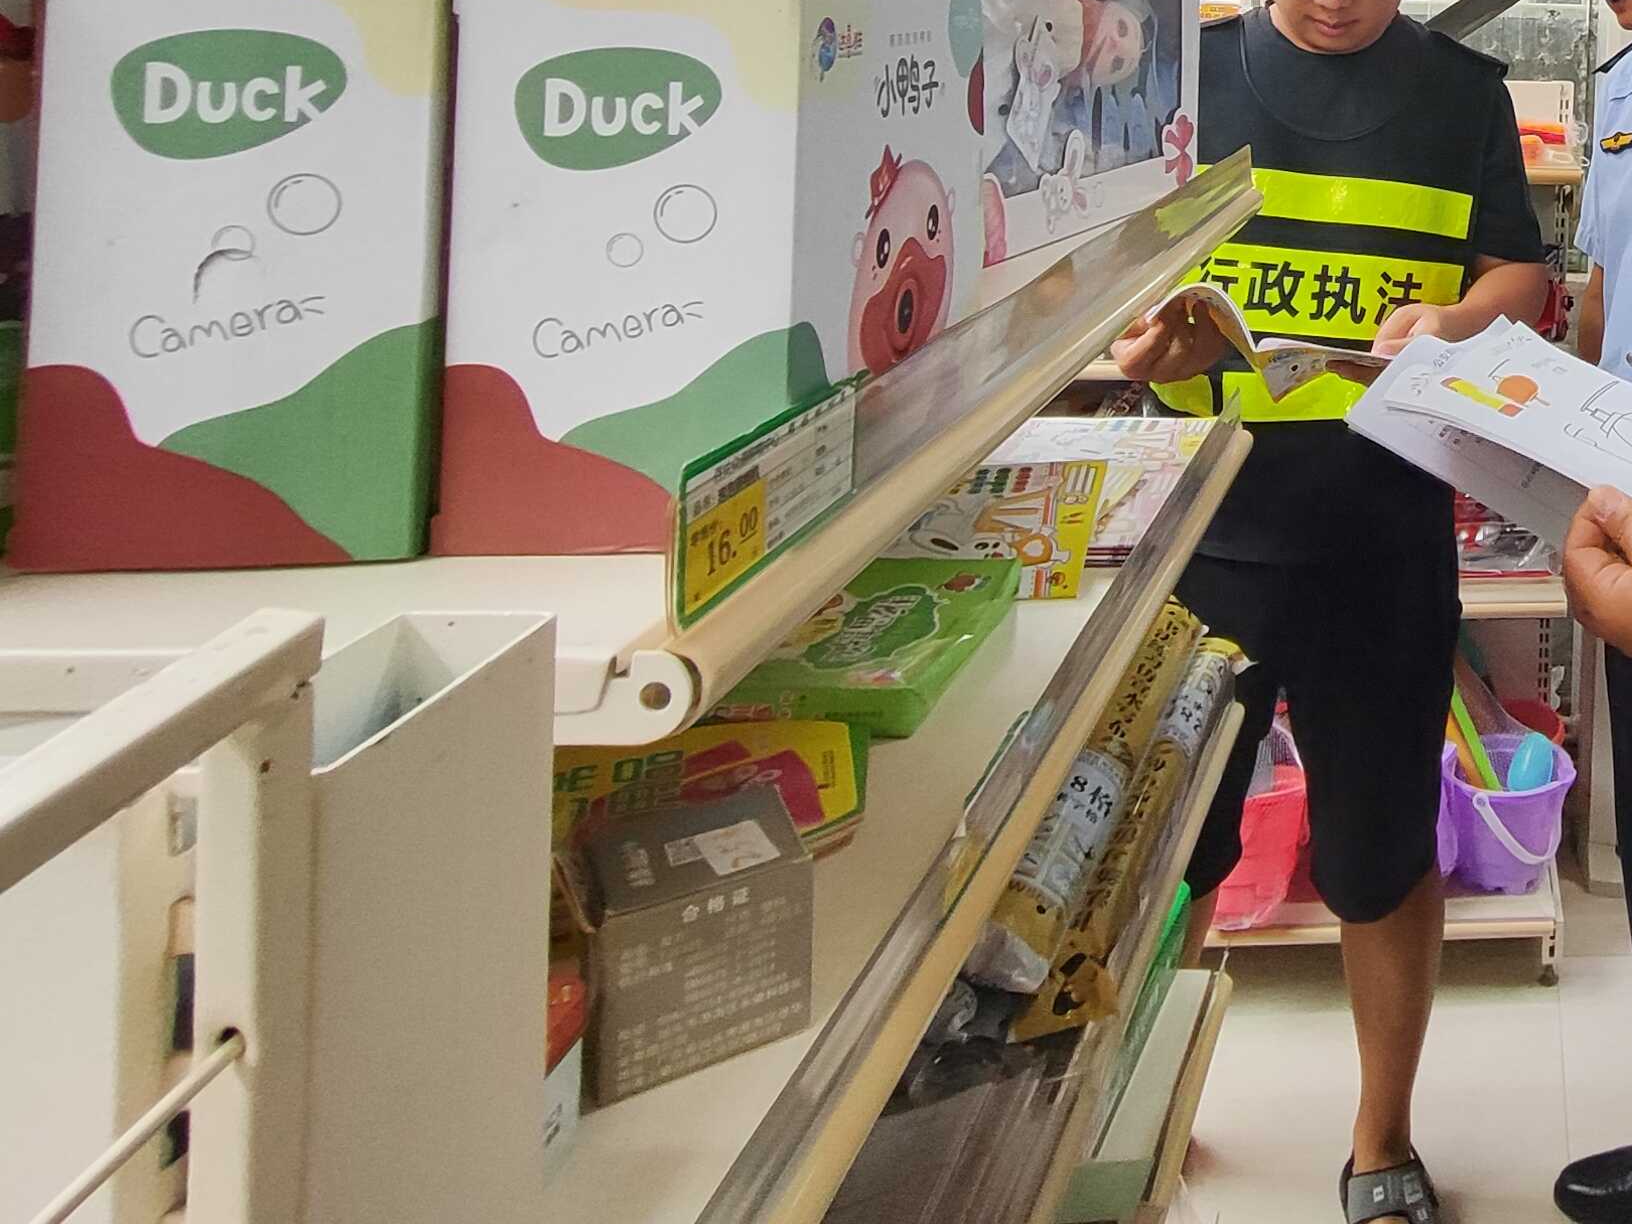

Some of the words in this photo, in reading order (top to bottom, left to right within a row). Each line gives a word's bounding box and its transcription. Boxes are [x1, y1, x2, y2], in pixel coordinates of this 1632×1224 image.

[143, 61, 328, 124] Duck
[541, 77, 705, 137] Duck
[876, 54, 939, 118] 小鸭子
[128, 299, 302, 359] Camera
[531, 303, 683, 359] Camera
[707, 505, 758, 577] 16.00
